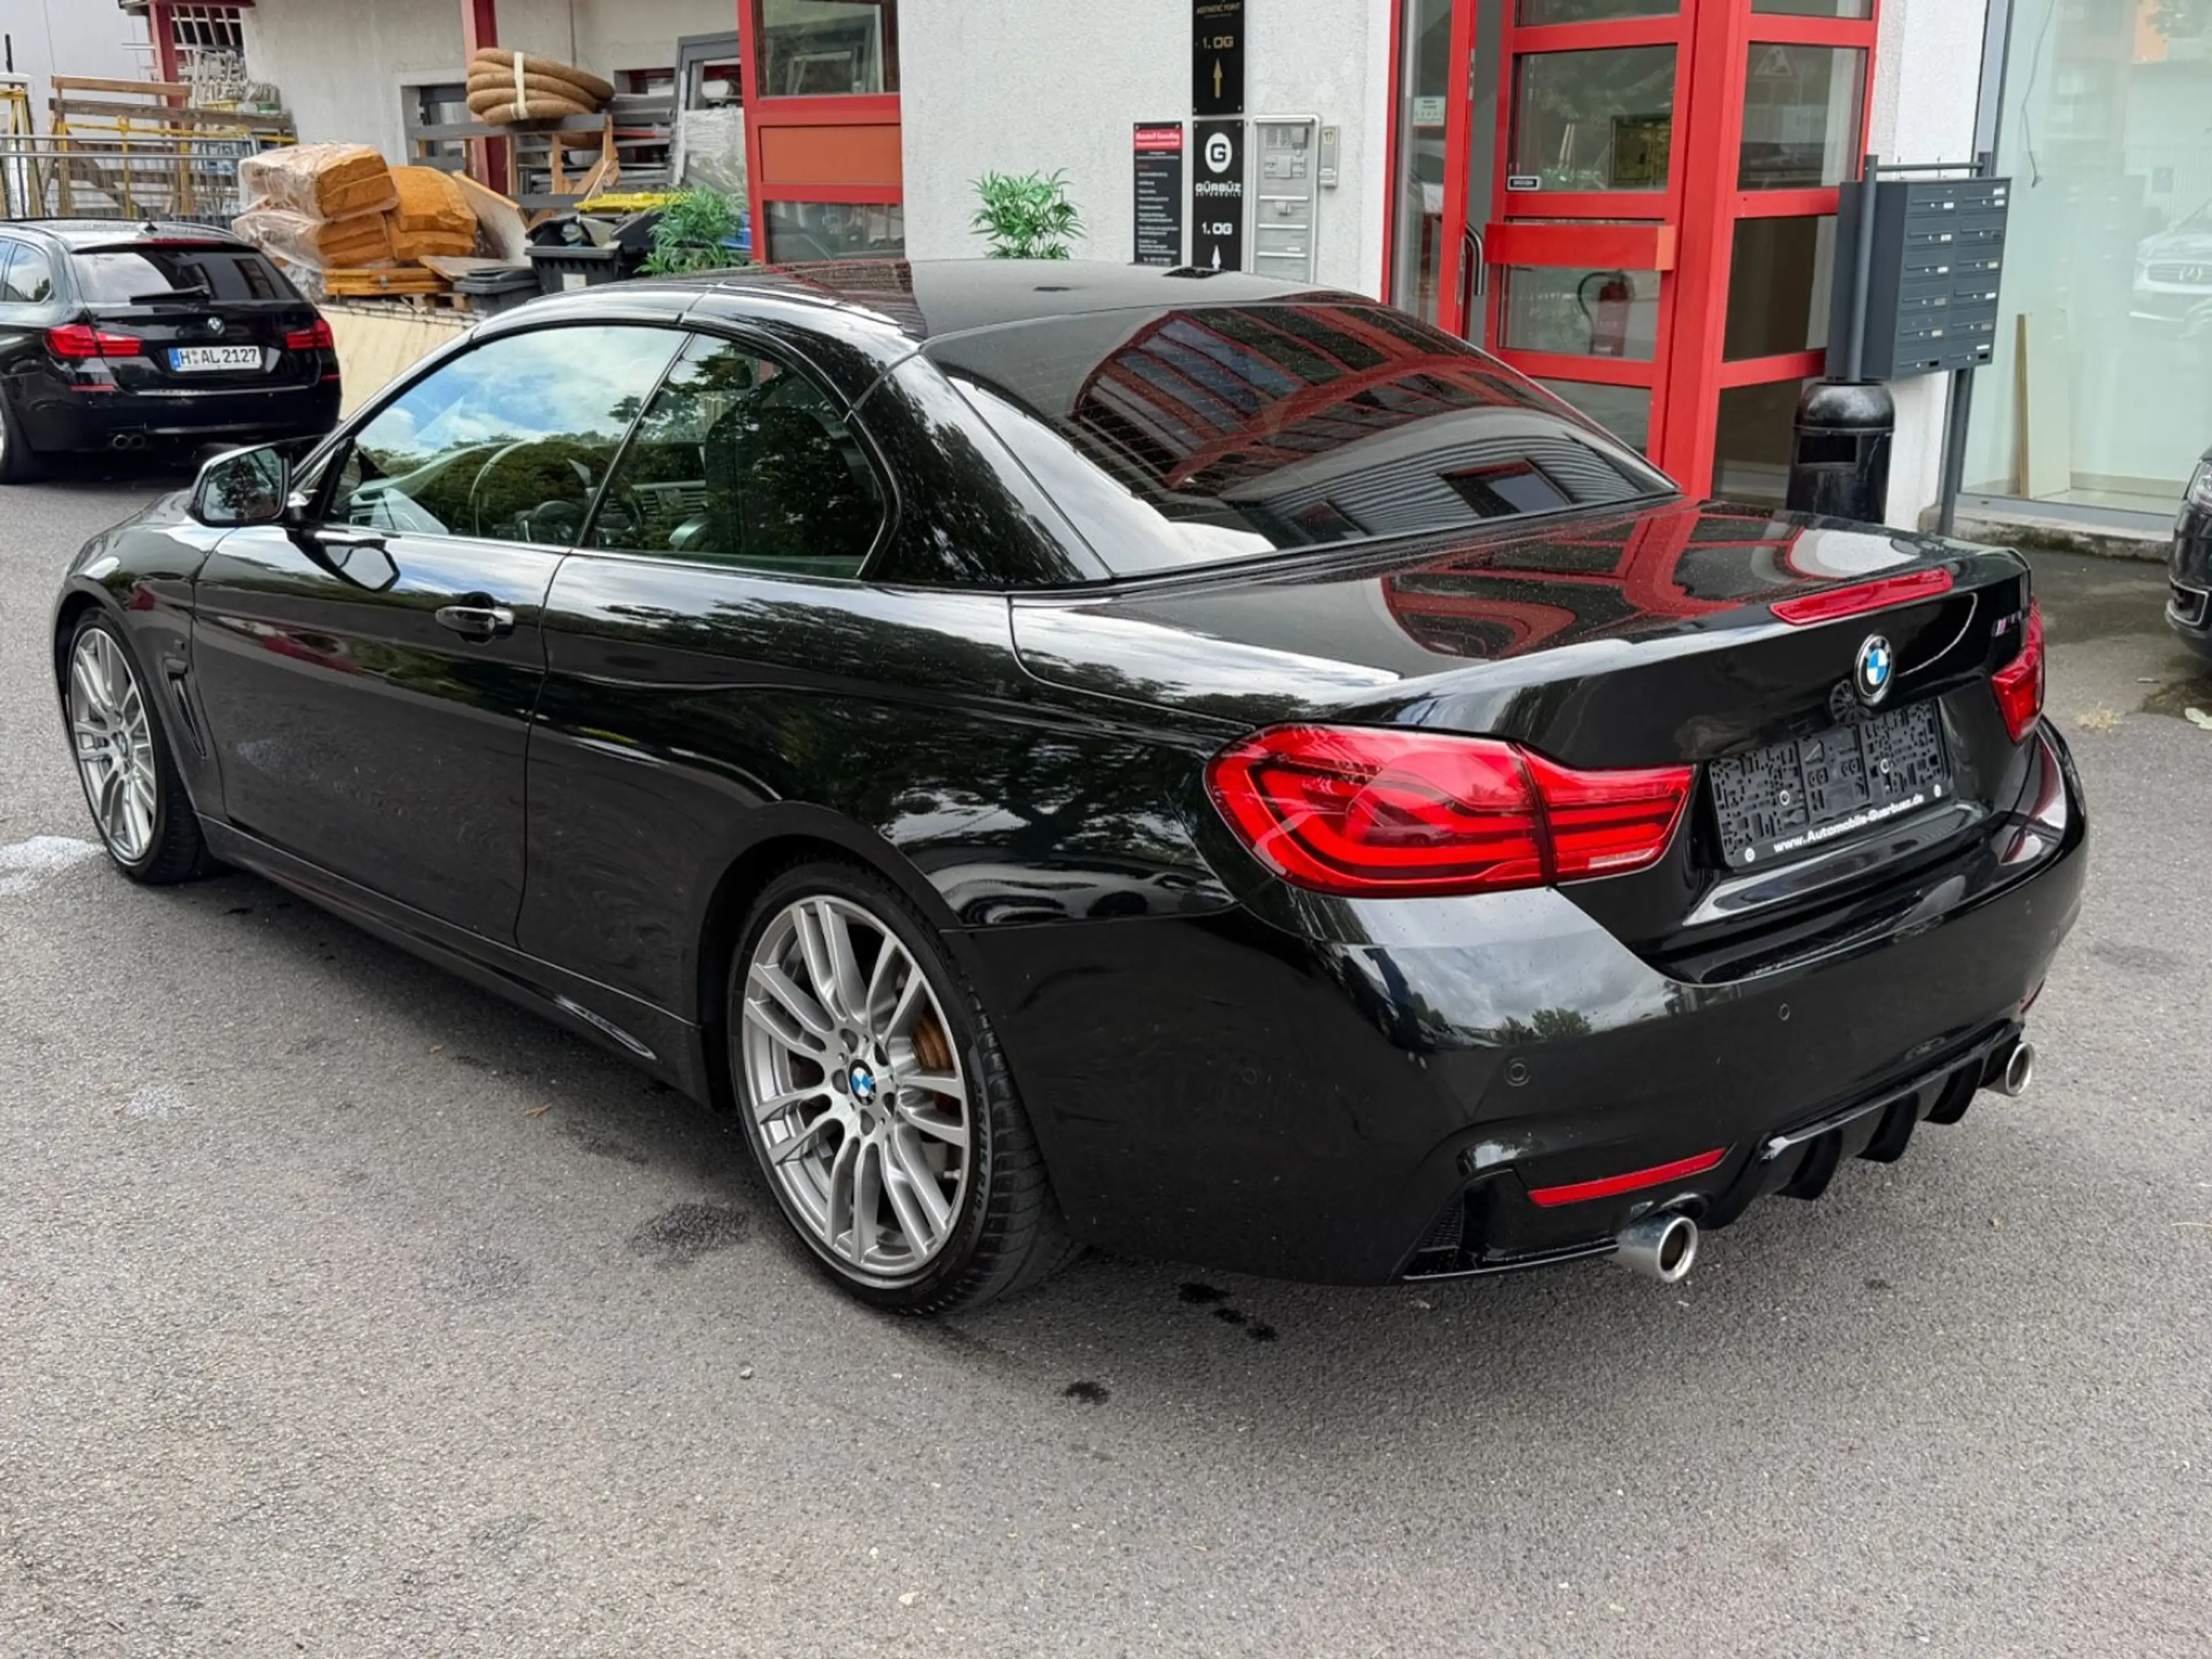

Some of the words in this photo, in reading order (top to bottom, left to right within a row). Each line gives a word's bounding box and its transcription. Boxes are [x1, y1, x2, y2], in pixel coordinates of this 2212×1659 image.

[1213, 36, 1234, 49] OG
[1211, 143, 1226, 162] G
[1202, 221, 1210, 235] 1.
[1212, 222, 1233, 236] OG
[179, 351, 191, 365] H
[202, 349, 221, 363] AL
[222, 348, 256, 363] 2127
